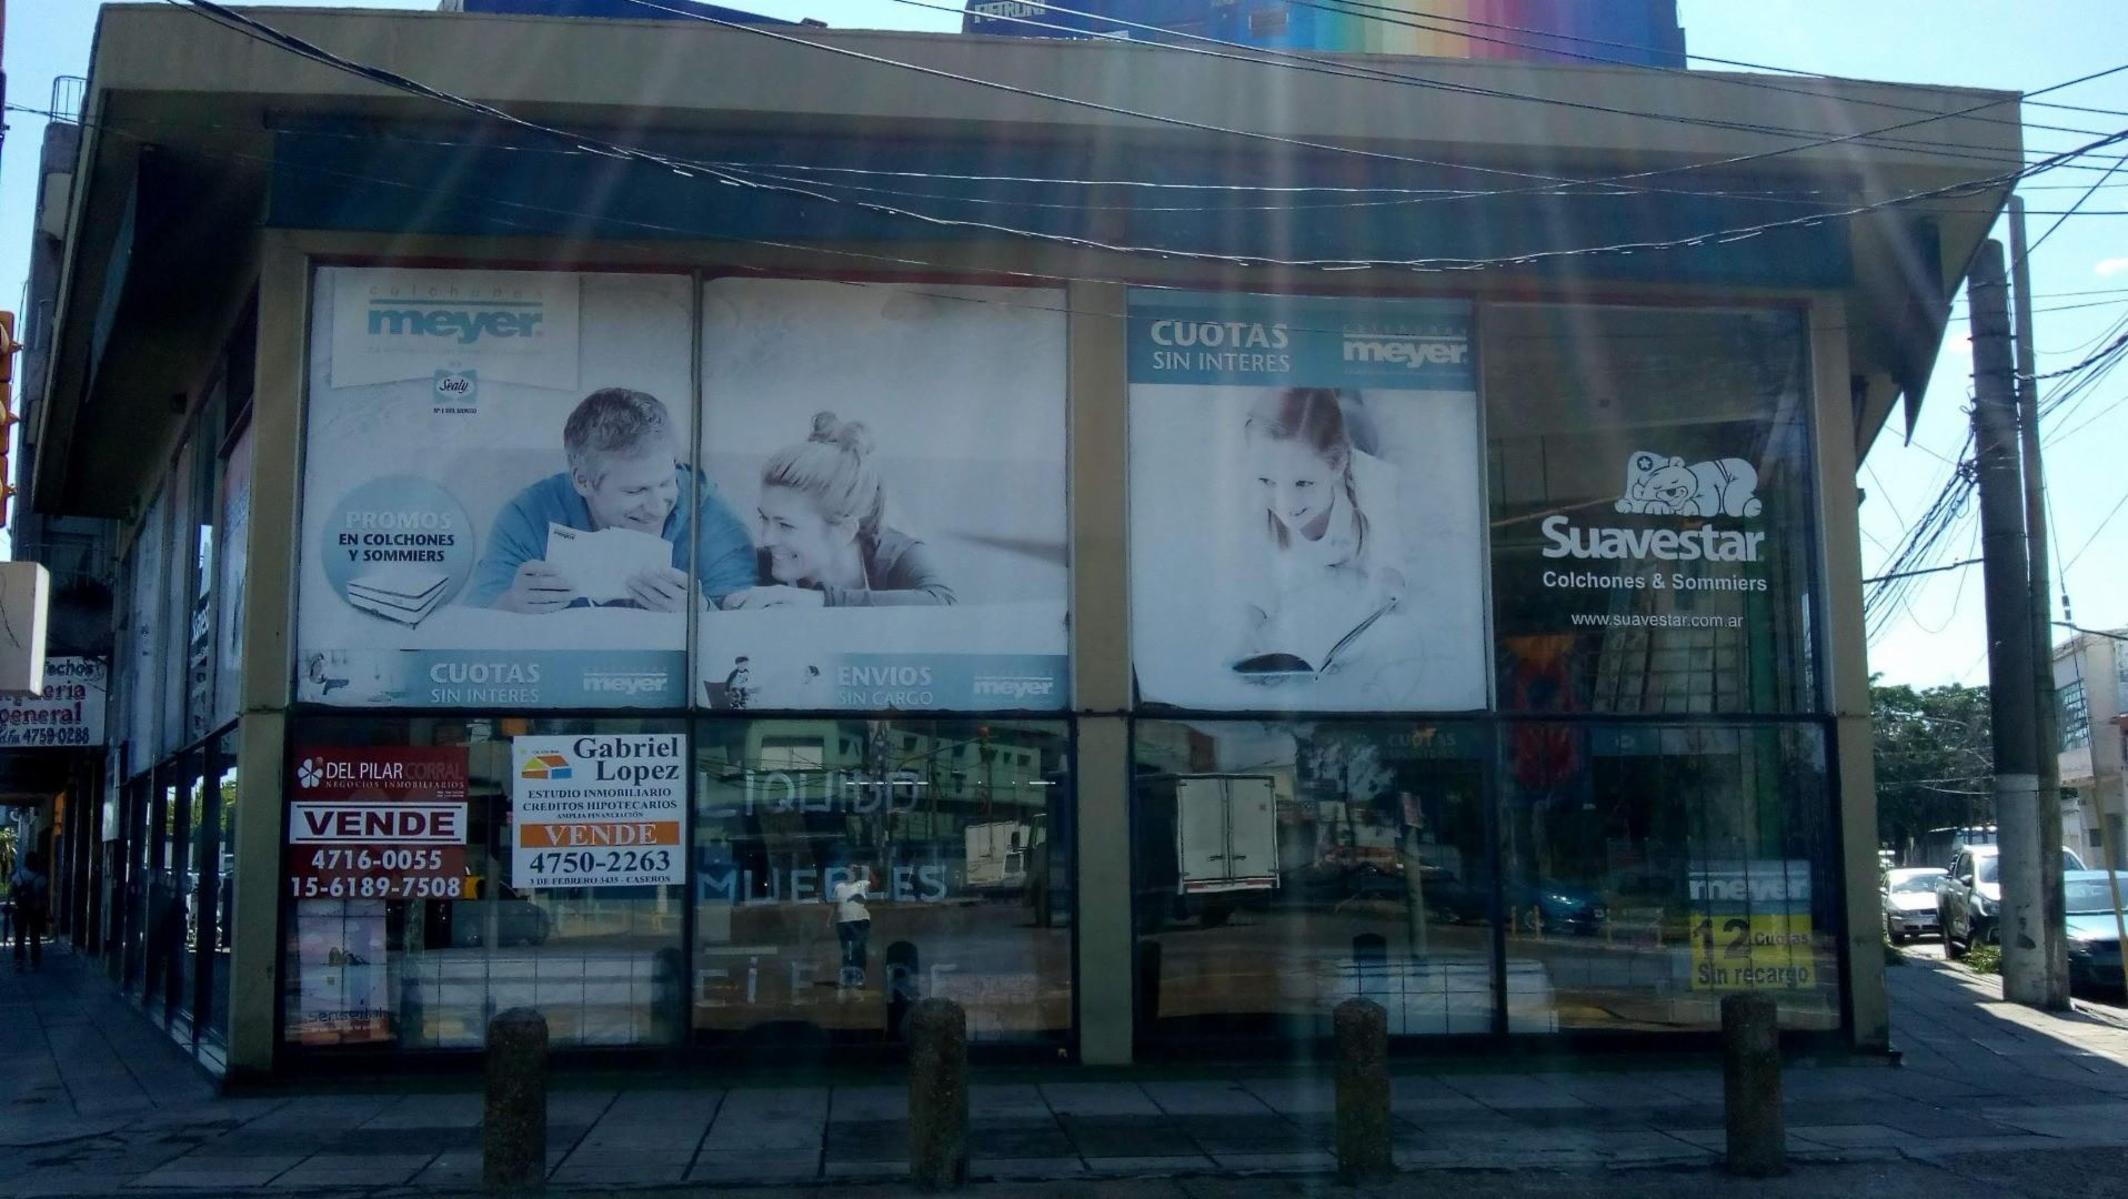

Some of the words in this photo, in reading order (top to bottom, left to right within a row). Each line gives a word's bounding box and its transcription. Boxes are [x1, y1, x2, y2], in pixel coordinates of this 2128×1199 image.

[368, 309, 543, 345] meyer
[1151, 320, 1289, 349] CUOTAS
[1343, 341, 1468, 368] meyer
[1152, 351, 1190, 370] SIN
[1199, 352, 1290, 373] INTERES
[439, 378, 469, 394] Sealy
[345, 511, 451, 530] PROMOS
[339, 533, 358, 546] EN
[363, 534, 455, 547] COLCHONES
[1541, 515, 1765, 562] Suavestar
[349, 550, 358, 562] Y
[362, 550, 445, 563] SOMMIERS
[1542, 570, 1646, 589] Colchones
[1652, 572, 1666, 589] &
[1672, 574, 1768, 592] Sommiers
[1571, 612, 1744, 629] www.suavestar.com.ar
[44, 659, 95, 677] echos
[430, 663, 541, 684] CUOTAS
[583, 675, 669, 695] meyer
[838, 666, 933, 687] ENVIOS
[973, 680, 1054, 699] meyer
[431, 688, 459, 703] SIN
[467, 688, 539, 703] INTERES
[838, 690, 867, 705] SIN
[874, 690, 933, 705] CARGO
[573, 736, 679, 759] Gabriel
[326, 762, 356, 780] DEL
[360, 762, 403, 780] PILAR
[405, 762, 464, 780] CORRAL
[595, 760, 680, 786] Lopez
[528, 789, 581, 799] ESTUDIO
[584, 787, 672, 798] INMOBILIARIO
[587, 800, 678, 811] HIPOTECARIOS
[303, 811, 455, 836] VENDE
[544, 823, 657, 847] VENDE
[311, 849, 442, 870] 4716-0055
[529, 850, 671, 874] 4750-2263
[290, 876, 461, 897] 15-6189-7508
[1692, 918, 1750, 960] 12
[1698, 963, 1728, 985] Sin
[1735, 963, 1809, 987] recargo
